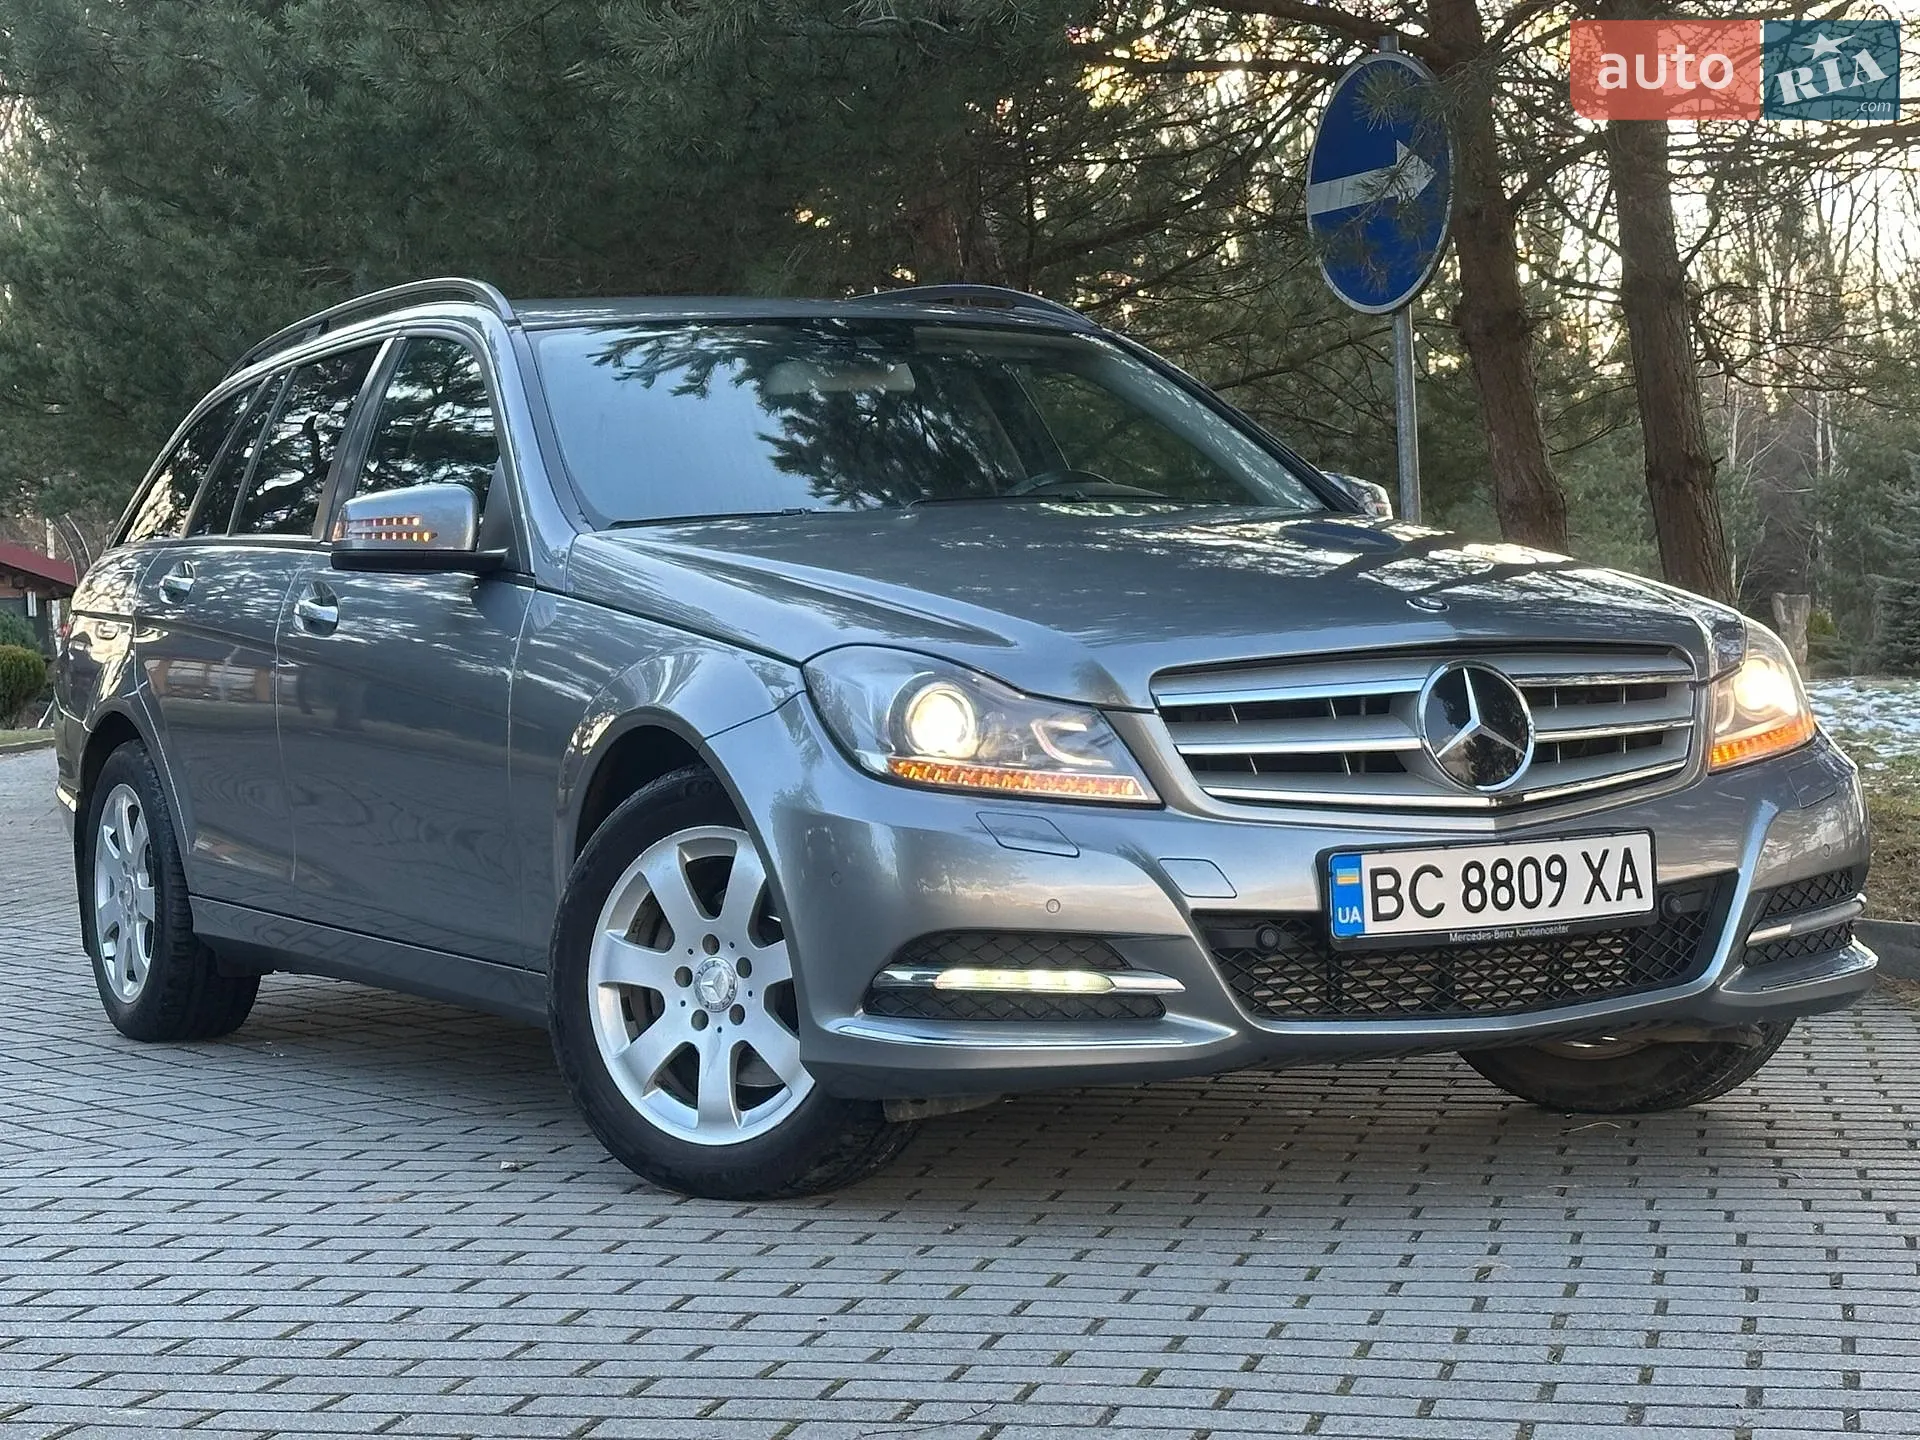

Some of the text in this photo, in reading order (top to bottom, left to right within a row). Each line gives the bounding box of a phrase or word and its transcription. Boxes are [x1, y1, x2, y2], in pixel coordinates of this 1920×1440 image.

[1369, 847, 1644, 922] BC 8809 XA
[1338, 906, 1362, 924] UA
[1449, 924, 1570, 942] Mercedes-Benz Kundencenter
